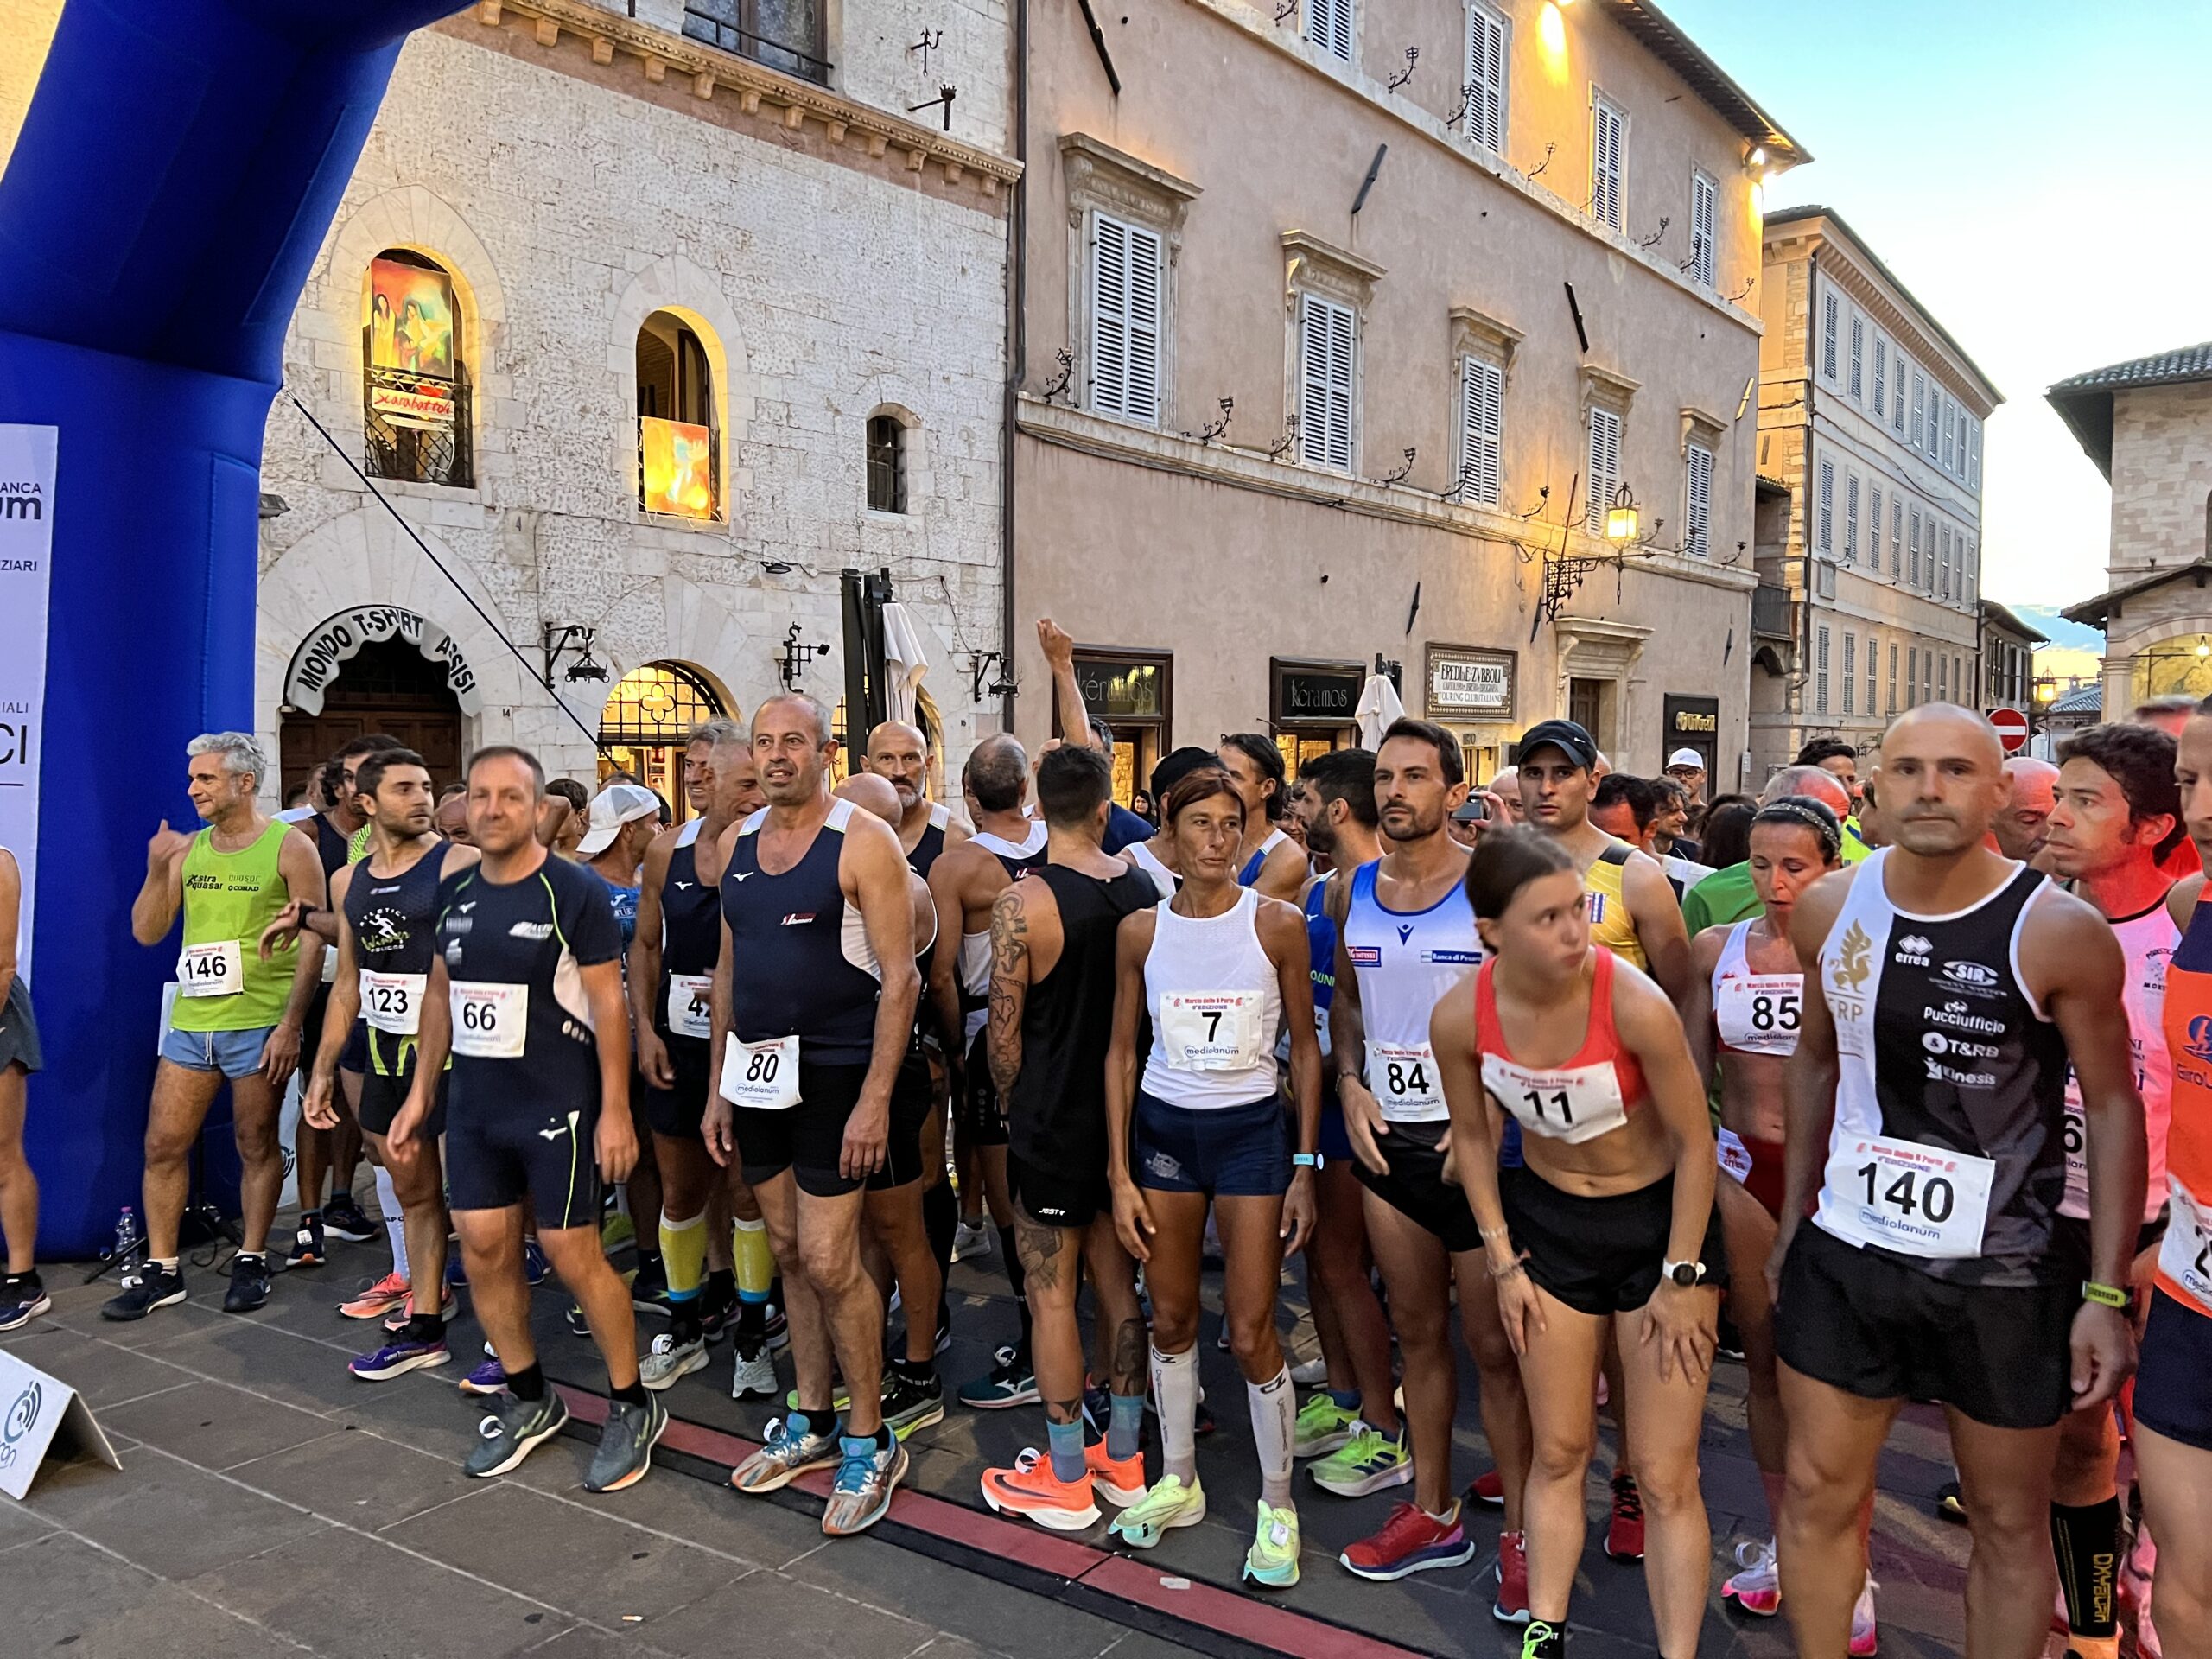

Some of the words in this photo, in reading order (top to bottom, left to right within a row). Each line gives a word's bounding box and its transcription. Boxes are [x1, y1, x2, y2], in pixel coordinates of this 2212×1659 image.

[297, 625, 353, 692] MONDO
[185, 955, 227, 980] 146
[1432, 952, 1452, 961] Banca
[1452, 952, 1459, 961] di
[1955, 964, 1986, 982] SIR
[368, 987, 409, 1014] 123
[1751, 995, 1802, 1031] 85
[463, 1002, 497, 1032] 66
[1201, 1011, 1223, 1043] 7
[1923, 1006, 2005, 1033] Pucciufficio
[747, 1053, 779, 1084] 80
[1387, 1062, 1430, 1096] 84
[737, 1085, 779, 1095] mediolanum
[1523, 1090, 1573, 1123] 11
[1858, 1161, 1955, 1224] 140
[1861, 1210, 1941, 1241] mediolanum
